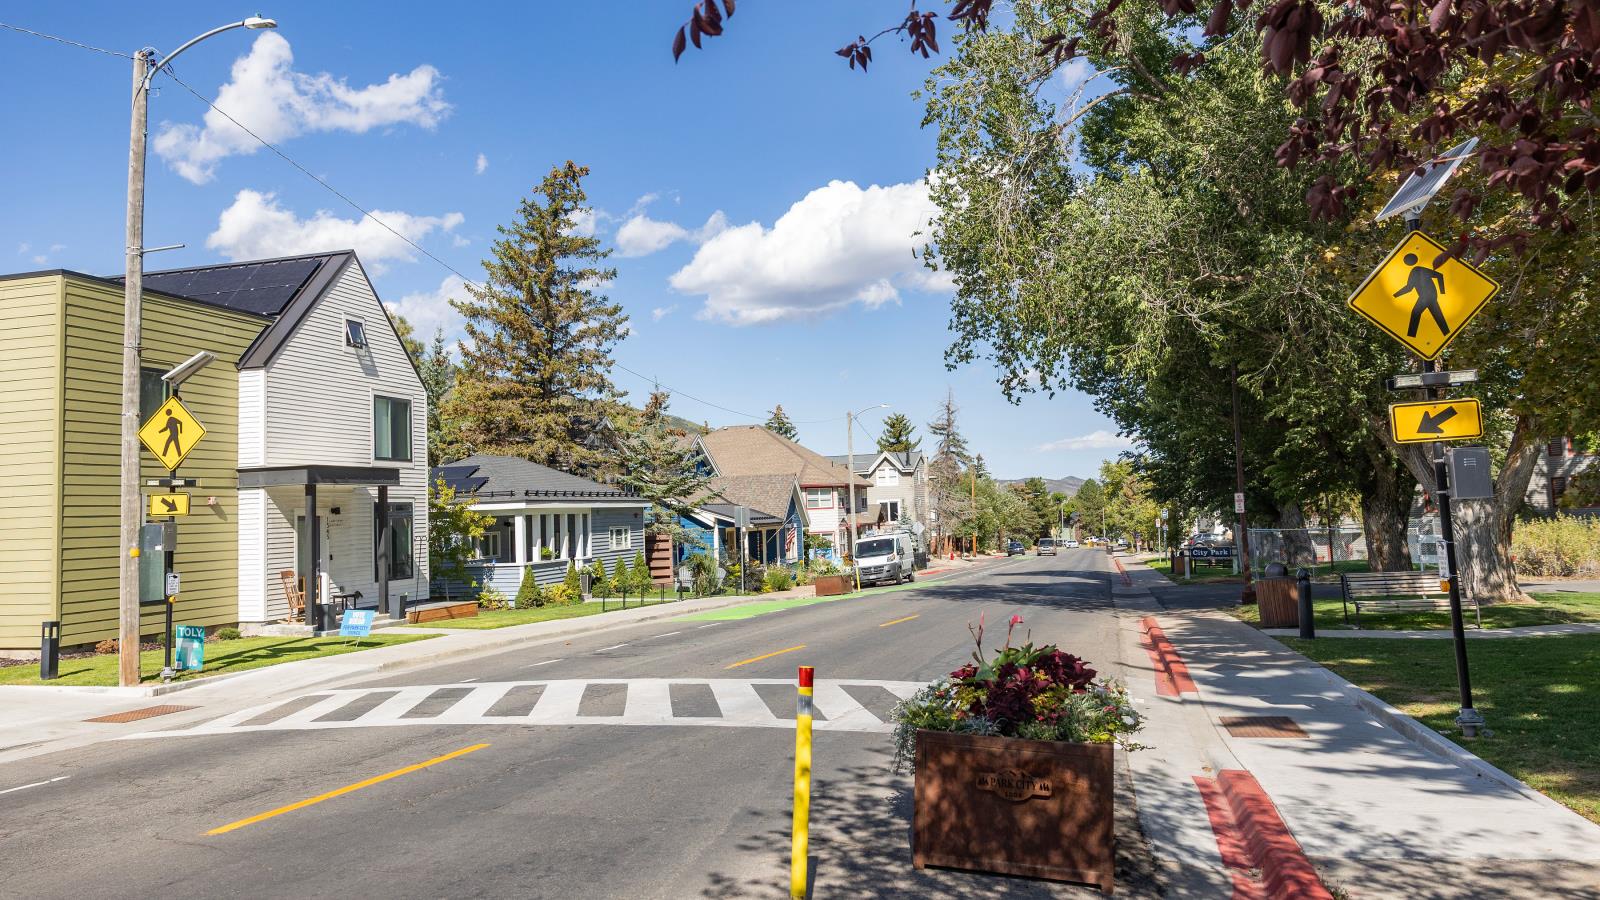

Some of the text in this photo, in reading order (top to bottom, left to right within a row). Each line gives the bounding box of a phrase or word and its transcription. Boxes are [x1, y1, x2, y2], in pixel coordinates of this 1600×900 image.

[178, 627, 202, 637] TOLY
[990, 776, 1036, 791] PARK CITY
